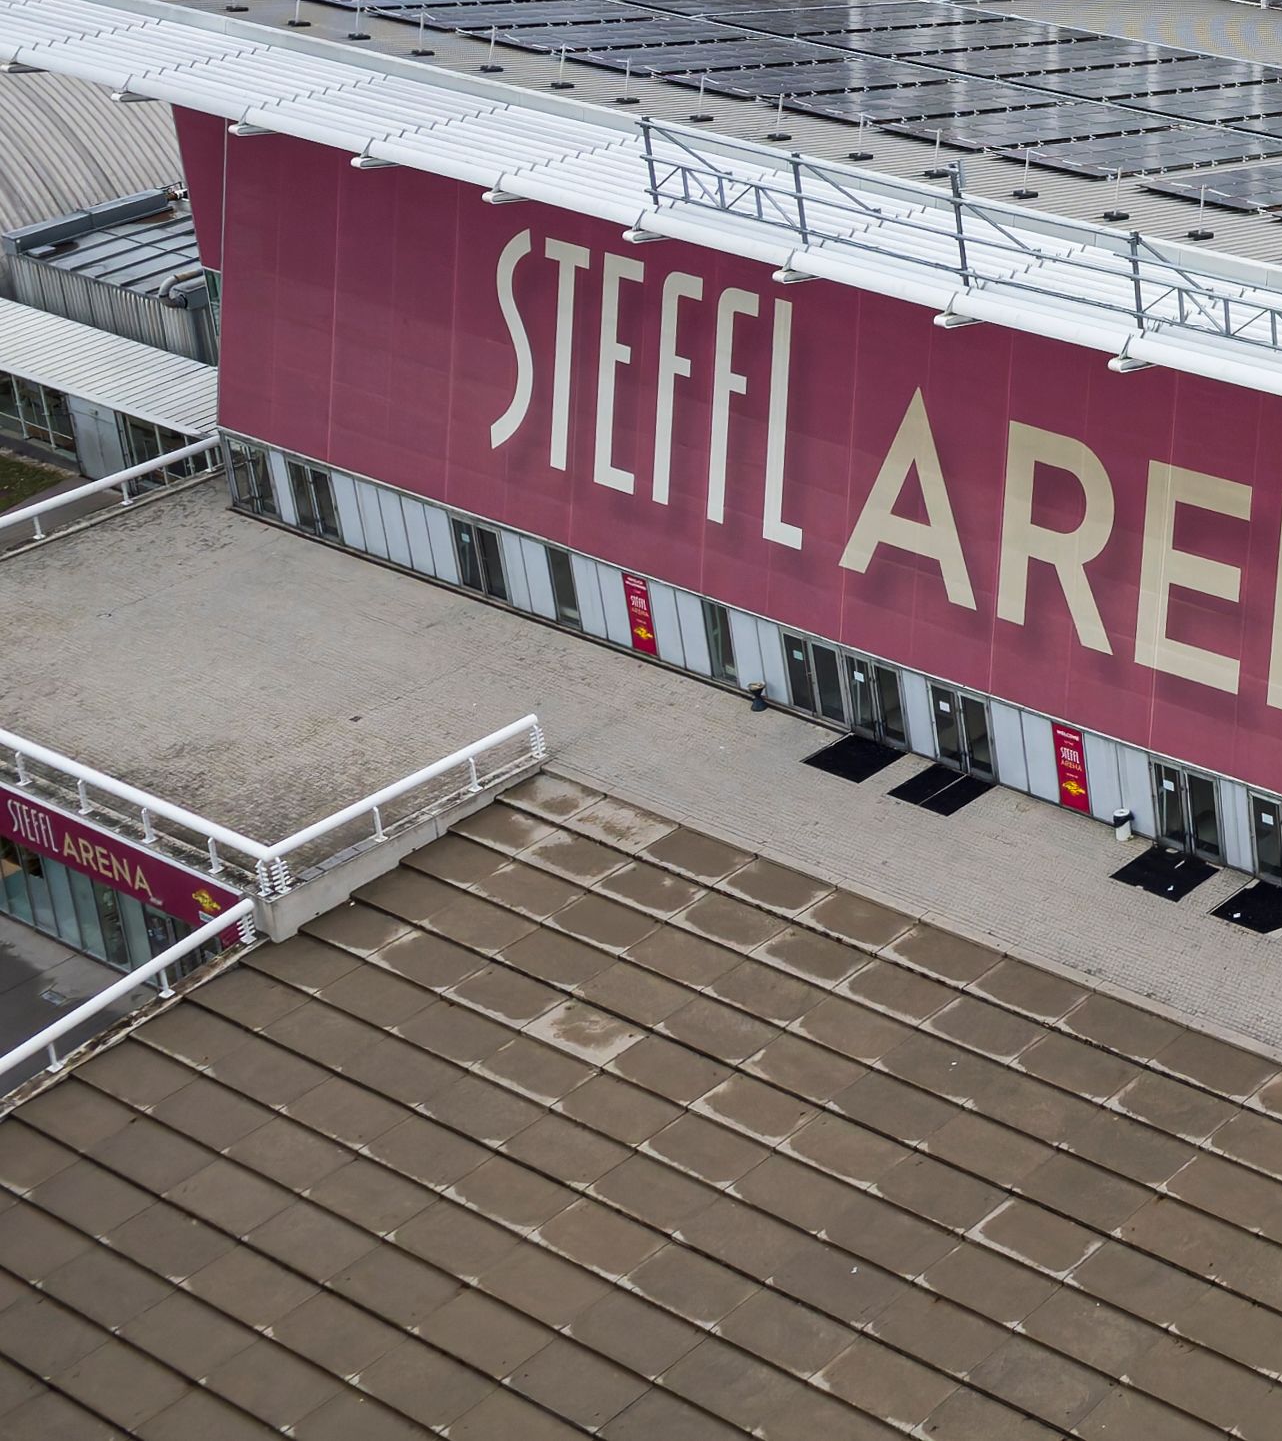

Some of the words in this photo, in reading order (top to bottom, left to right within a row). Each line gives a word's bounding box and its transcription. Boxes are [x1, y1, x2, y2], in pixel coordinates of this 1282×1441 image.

[490, 228, 804, 551] STEFFL
[6, 798, 59, 853] STEFFL
[63, 831, 153, 898] ARENA
